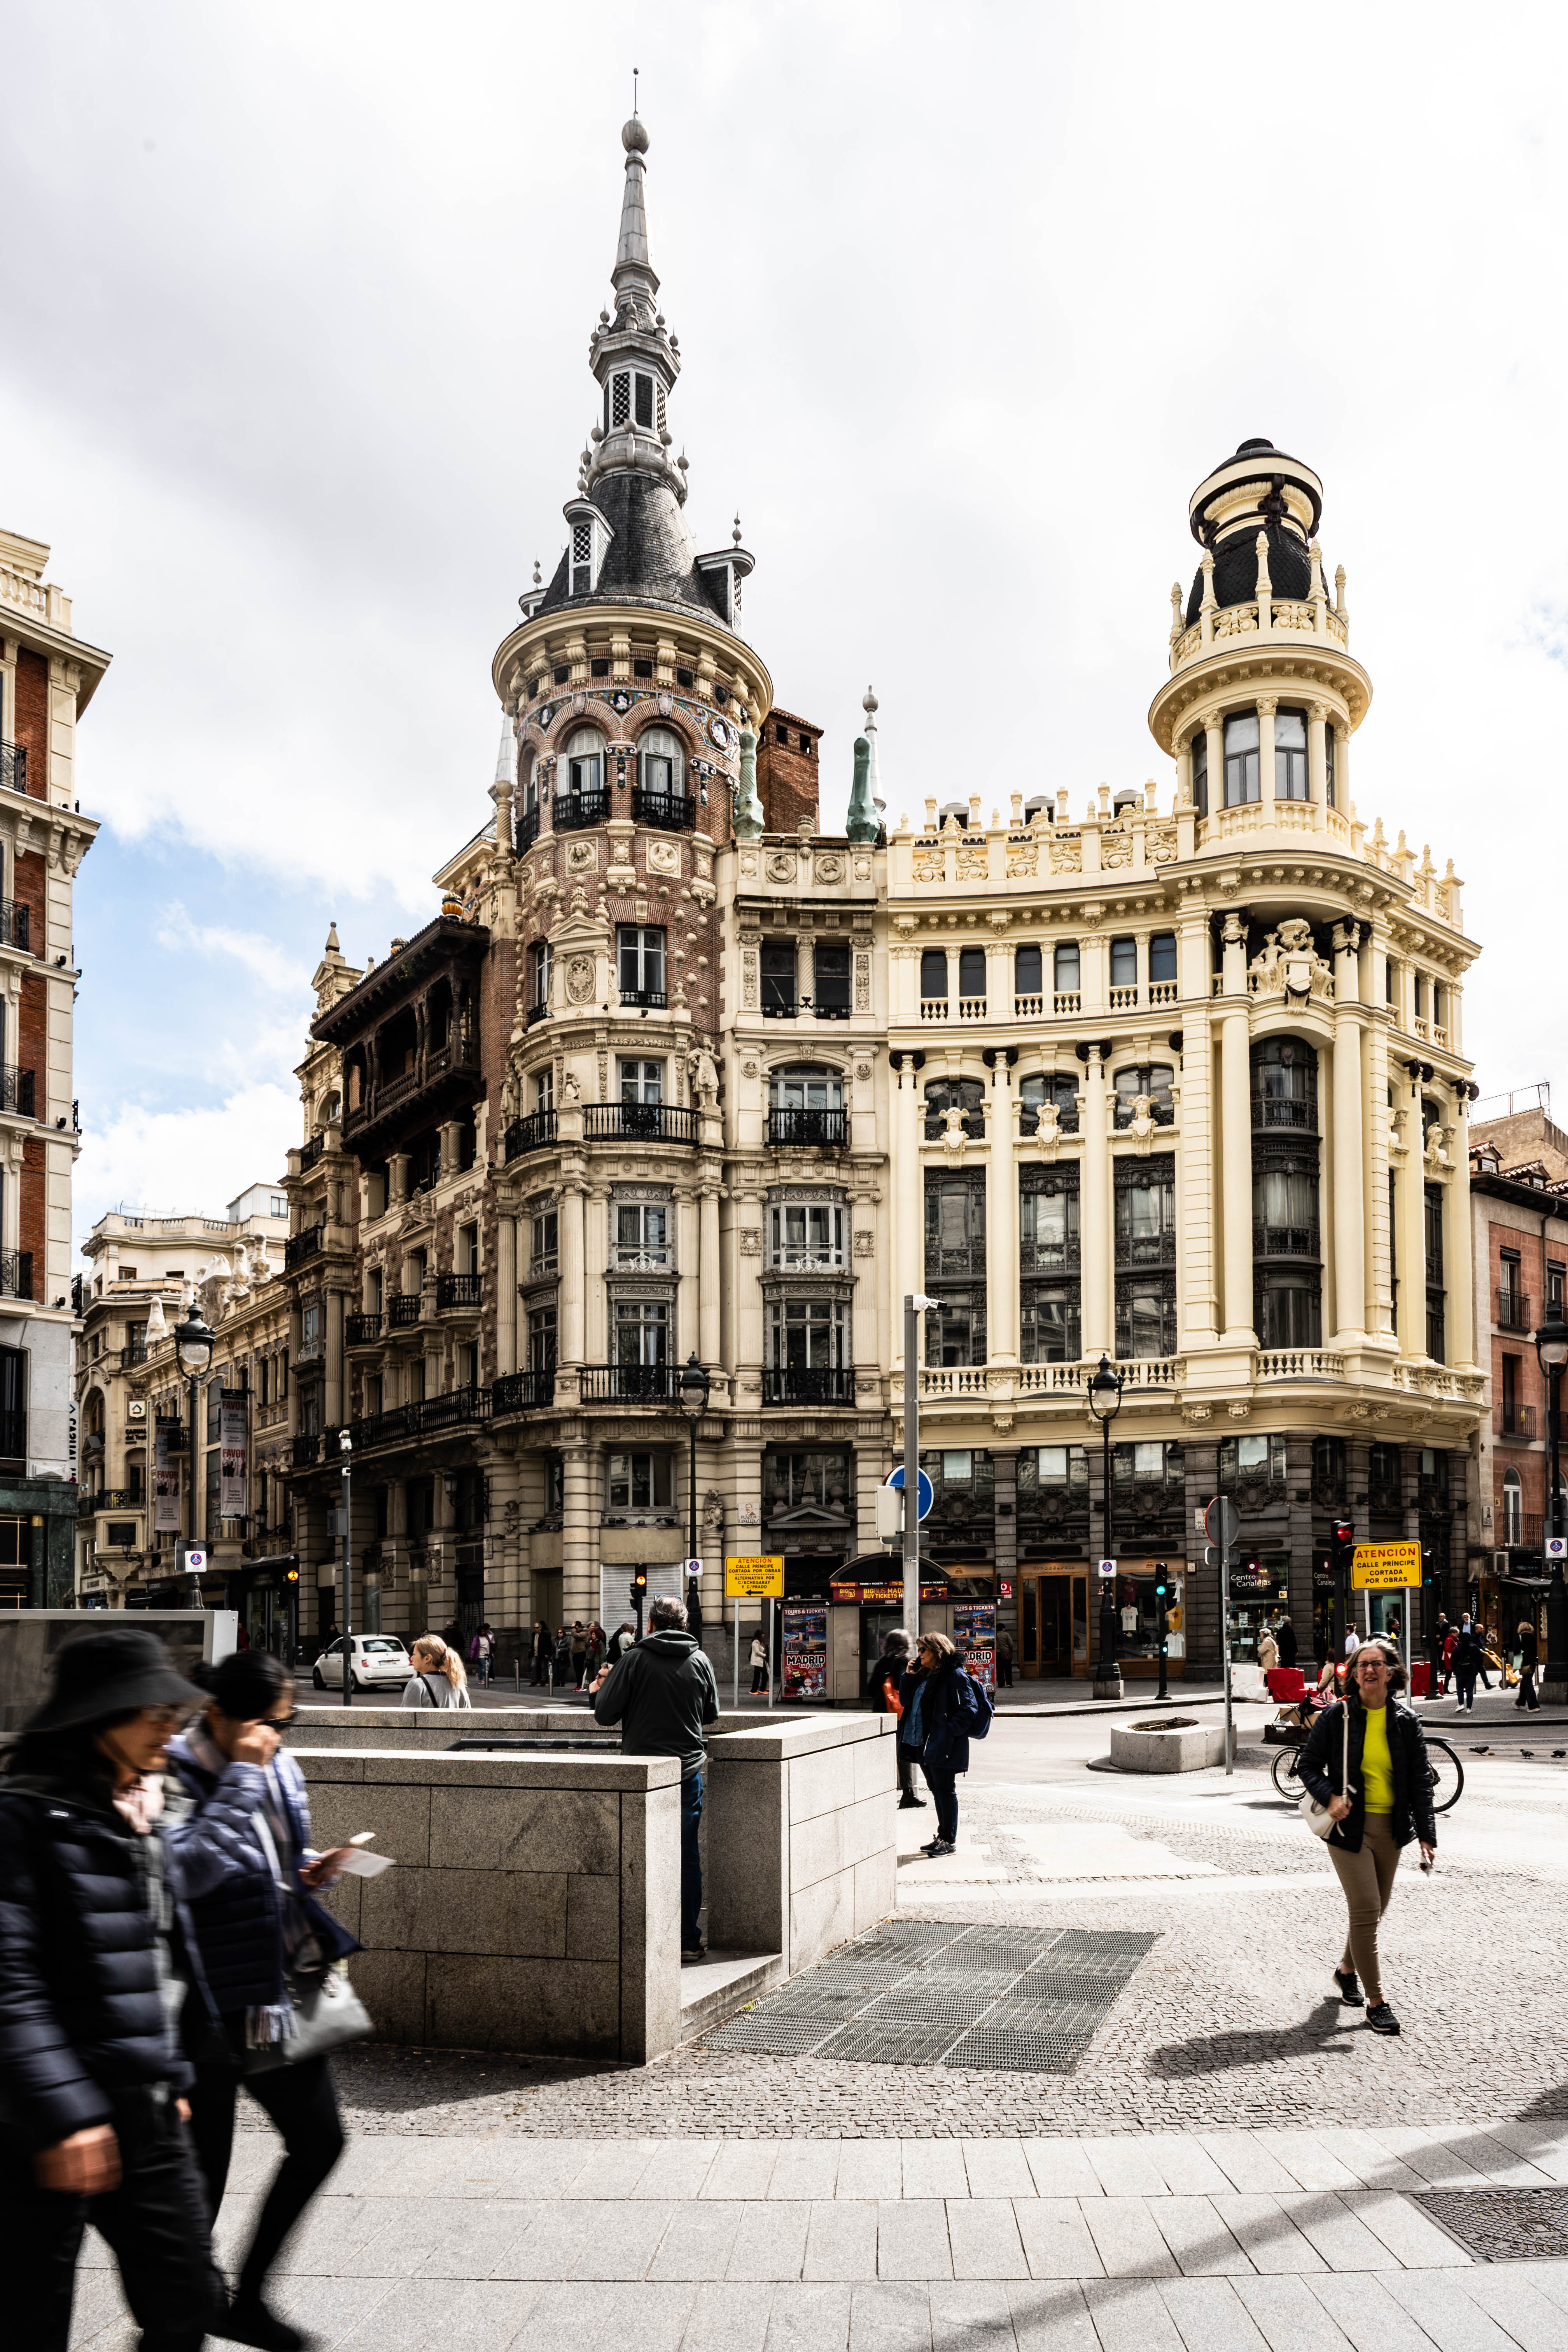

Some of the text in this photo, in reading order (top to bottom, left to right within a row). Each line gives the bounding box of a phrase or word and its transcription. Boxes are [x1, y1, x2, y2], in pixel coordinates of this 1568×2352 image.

[222, 1401, 245, 1410] FAVOR
[222, 1448, 245, 1458] FAVOR
[157, 1470, 178, 1479] FAVOR
[1356, 1547, 1415, 1559] ATENCIÓN
[787, 1655, 825, 1665] MADRID
[964, 1651, 992, 1660] ADRID
